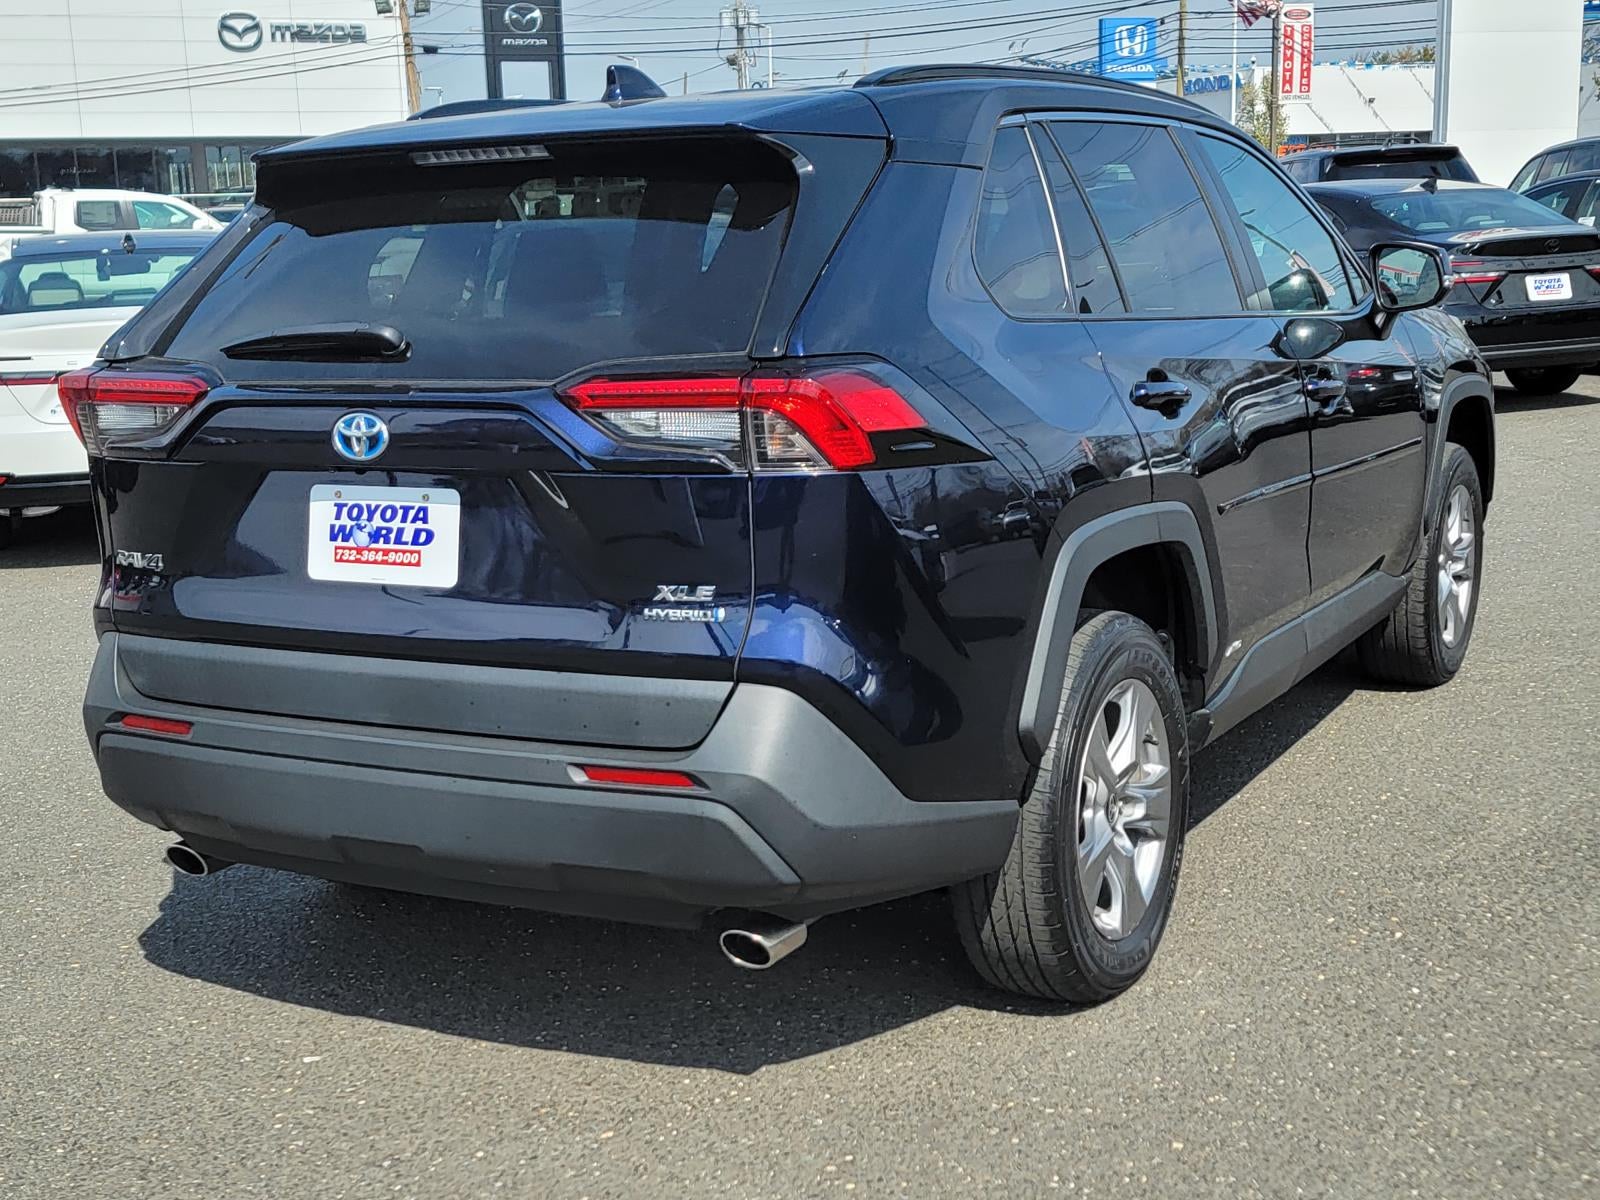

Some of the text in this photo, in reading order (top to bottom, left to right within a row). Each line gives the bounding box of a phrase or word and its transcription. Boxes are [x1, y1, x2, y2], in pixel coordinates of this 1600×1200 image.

[1283, 26, 1292, 92] TOYOTA
[1301, 26, 1310, 92] CERTIFIED
[1105, 64, 1155, 73] HONDA
[333, 502, 430, 525] TOYOTA
[116, 550, 164, 571] RAV4
[336, 549, 419, 564] 732-364-9000
[653, 585, 716, 601] XLE
[643, 608, 712, 622] HYBRID
